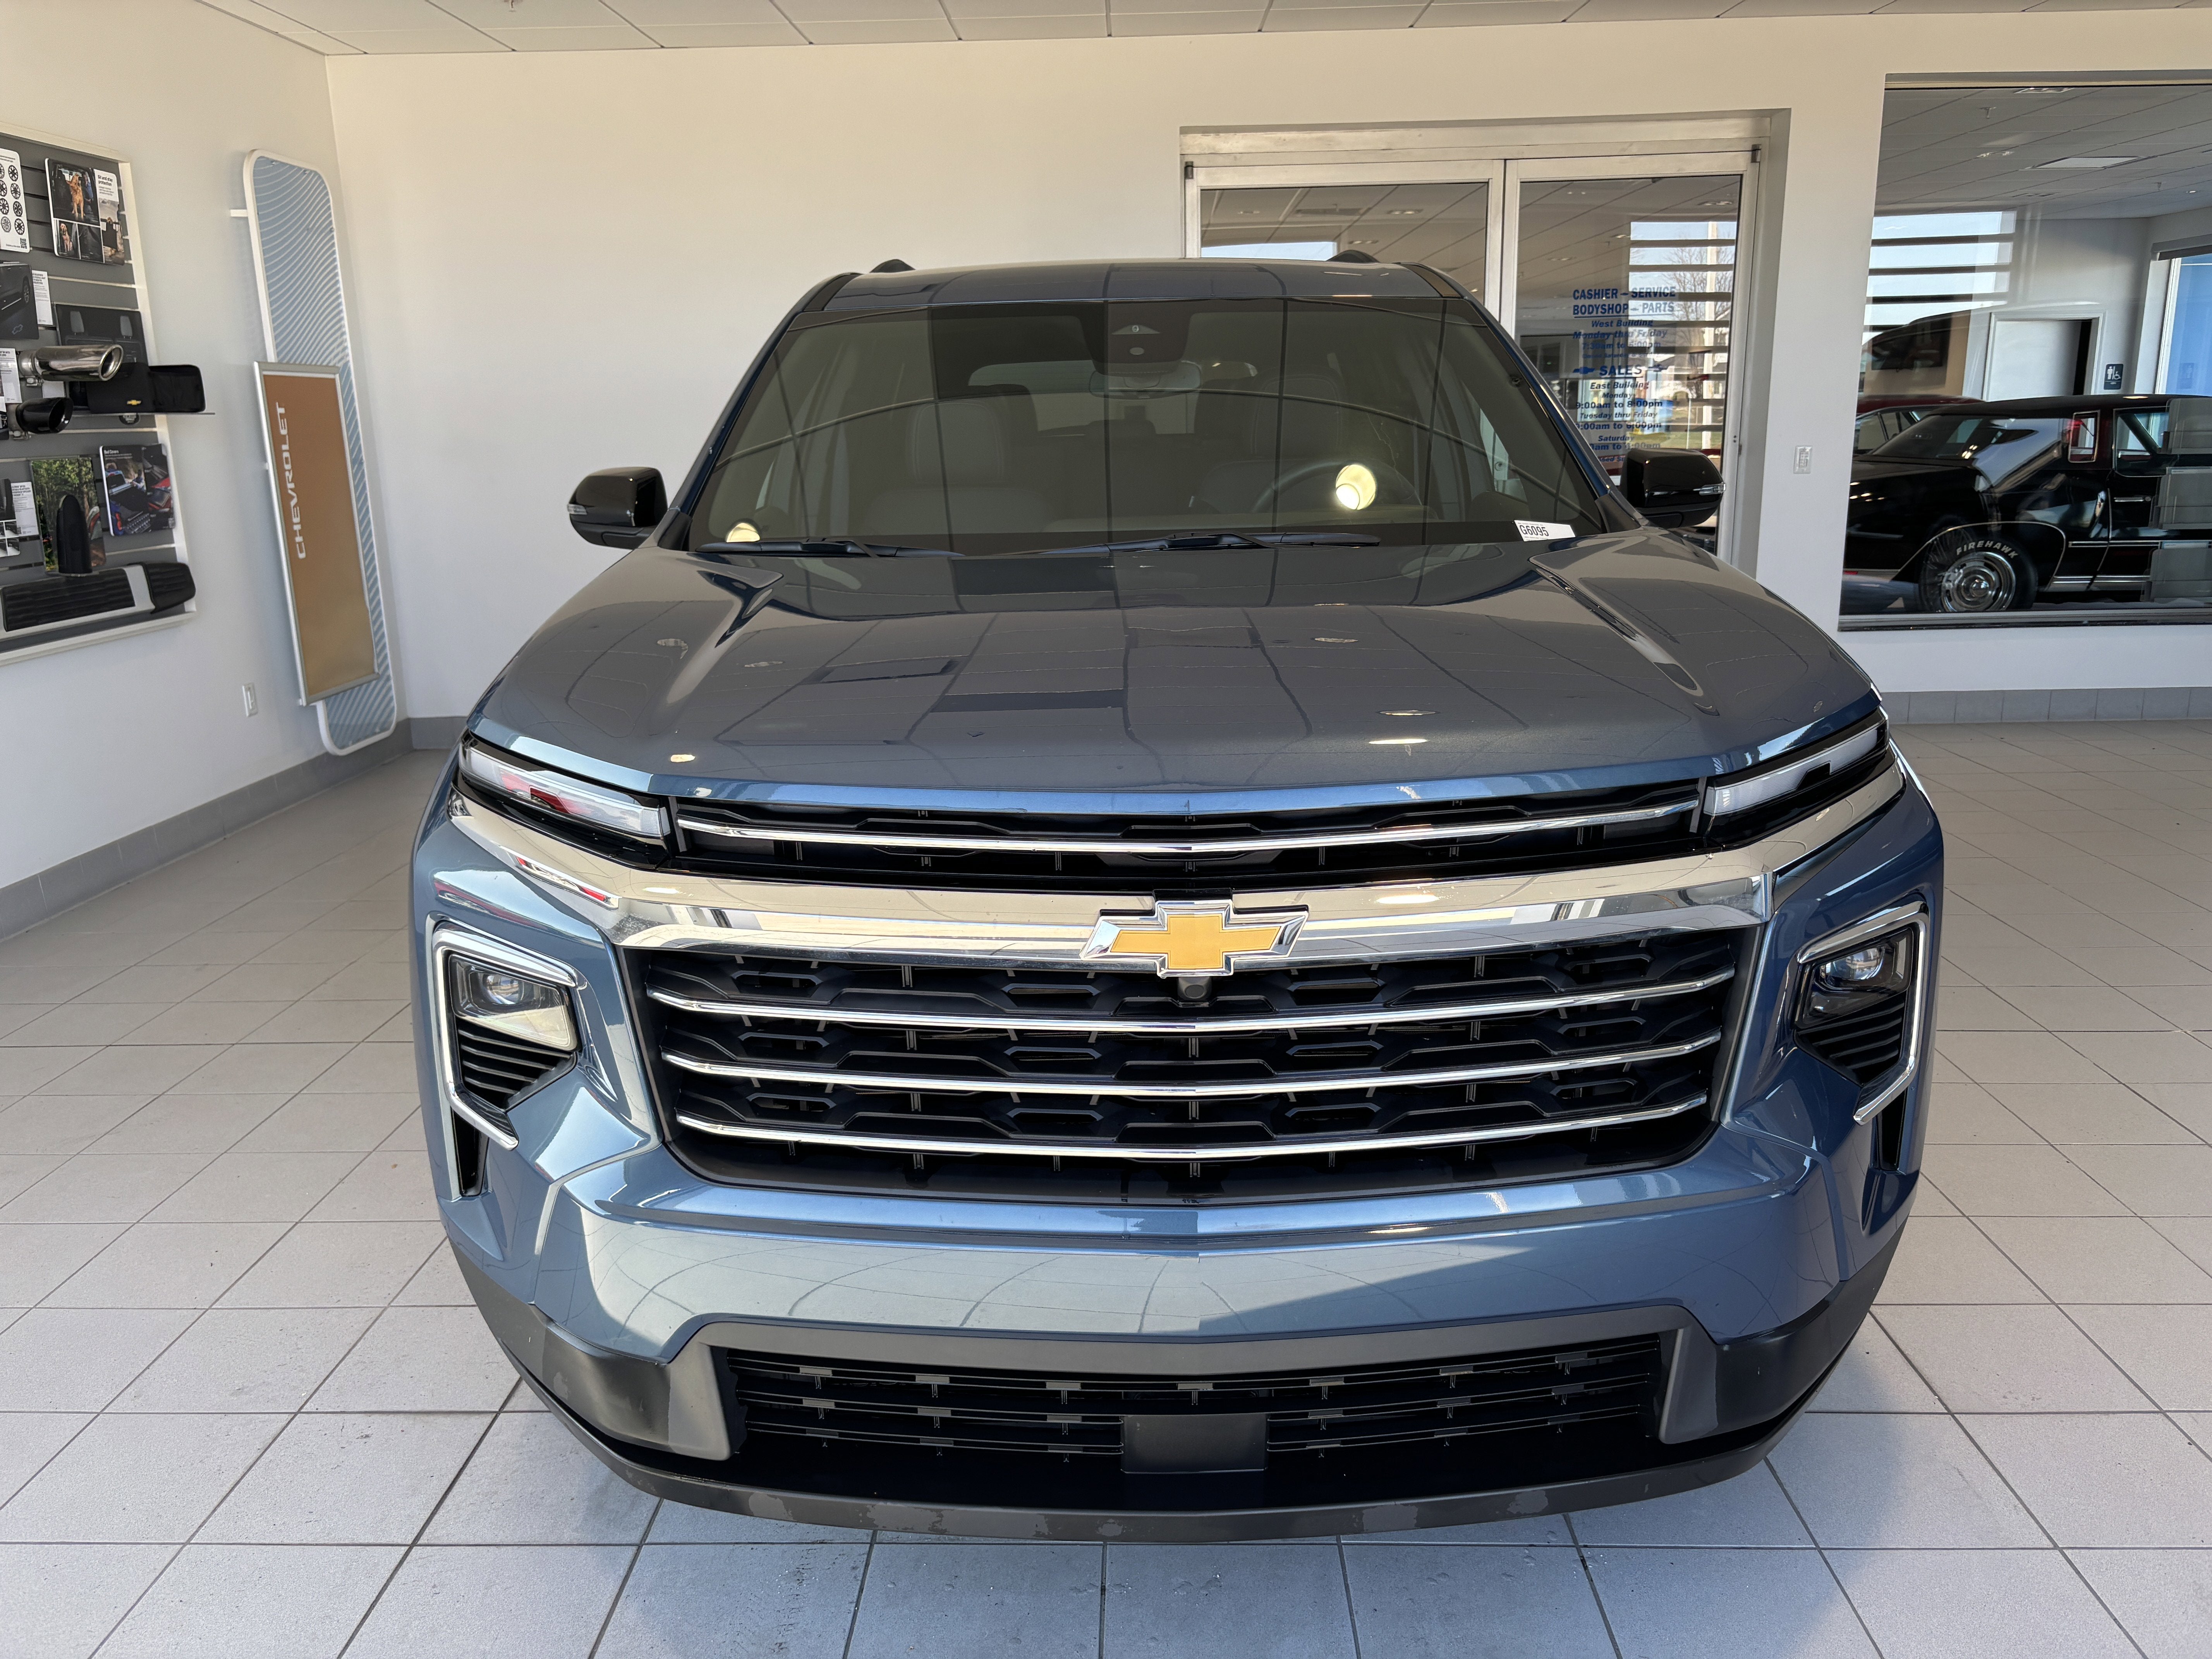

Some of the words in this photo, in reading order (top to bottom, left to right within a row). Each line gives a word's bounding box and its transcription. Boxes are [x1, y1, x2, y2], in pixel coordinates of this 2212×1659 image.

[1573, 289, 1618, 300] CASHIER
[1631, 287, 1676, 298] SERVICE
[1573, 303, 1628, 315] BODYSHOP
[1642, 302, 1674, 313] PARTS
[1573, 331, 1611, 340] Monday
[1599, 364, 1642, 376] SALES
[1614, 381, 1649, 390] Building
[1627, 400, 1662, 409] 8:00pm
[276, 402, 306, 559] CHEVROLET
[1520, 525, 1549, 536] G6095
[1956, 540, 2018, 558] FIREHAWK
